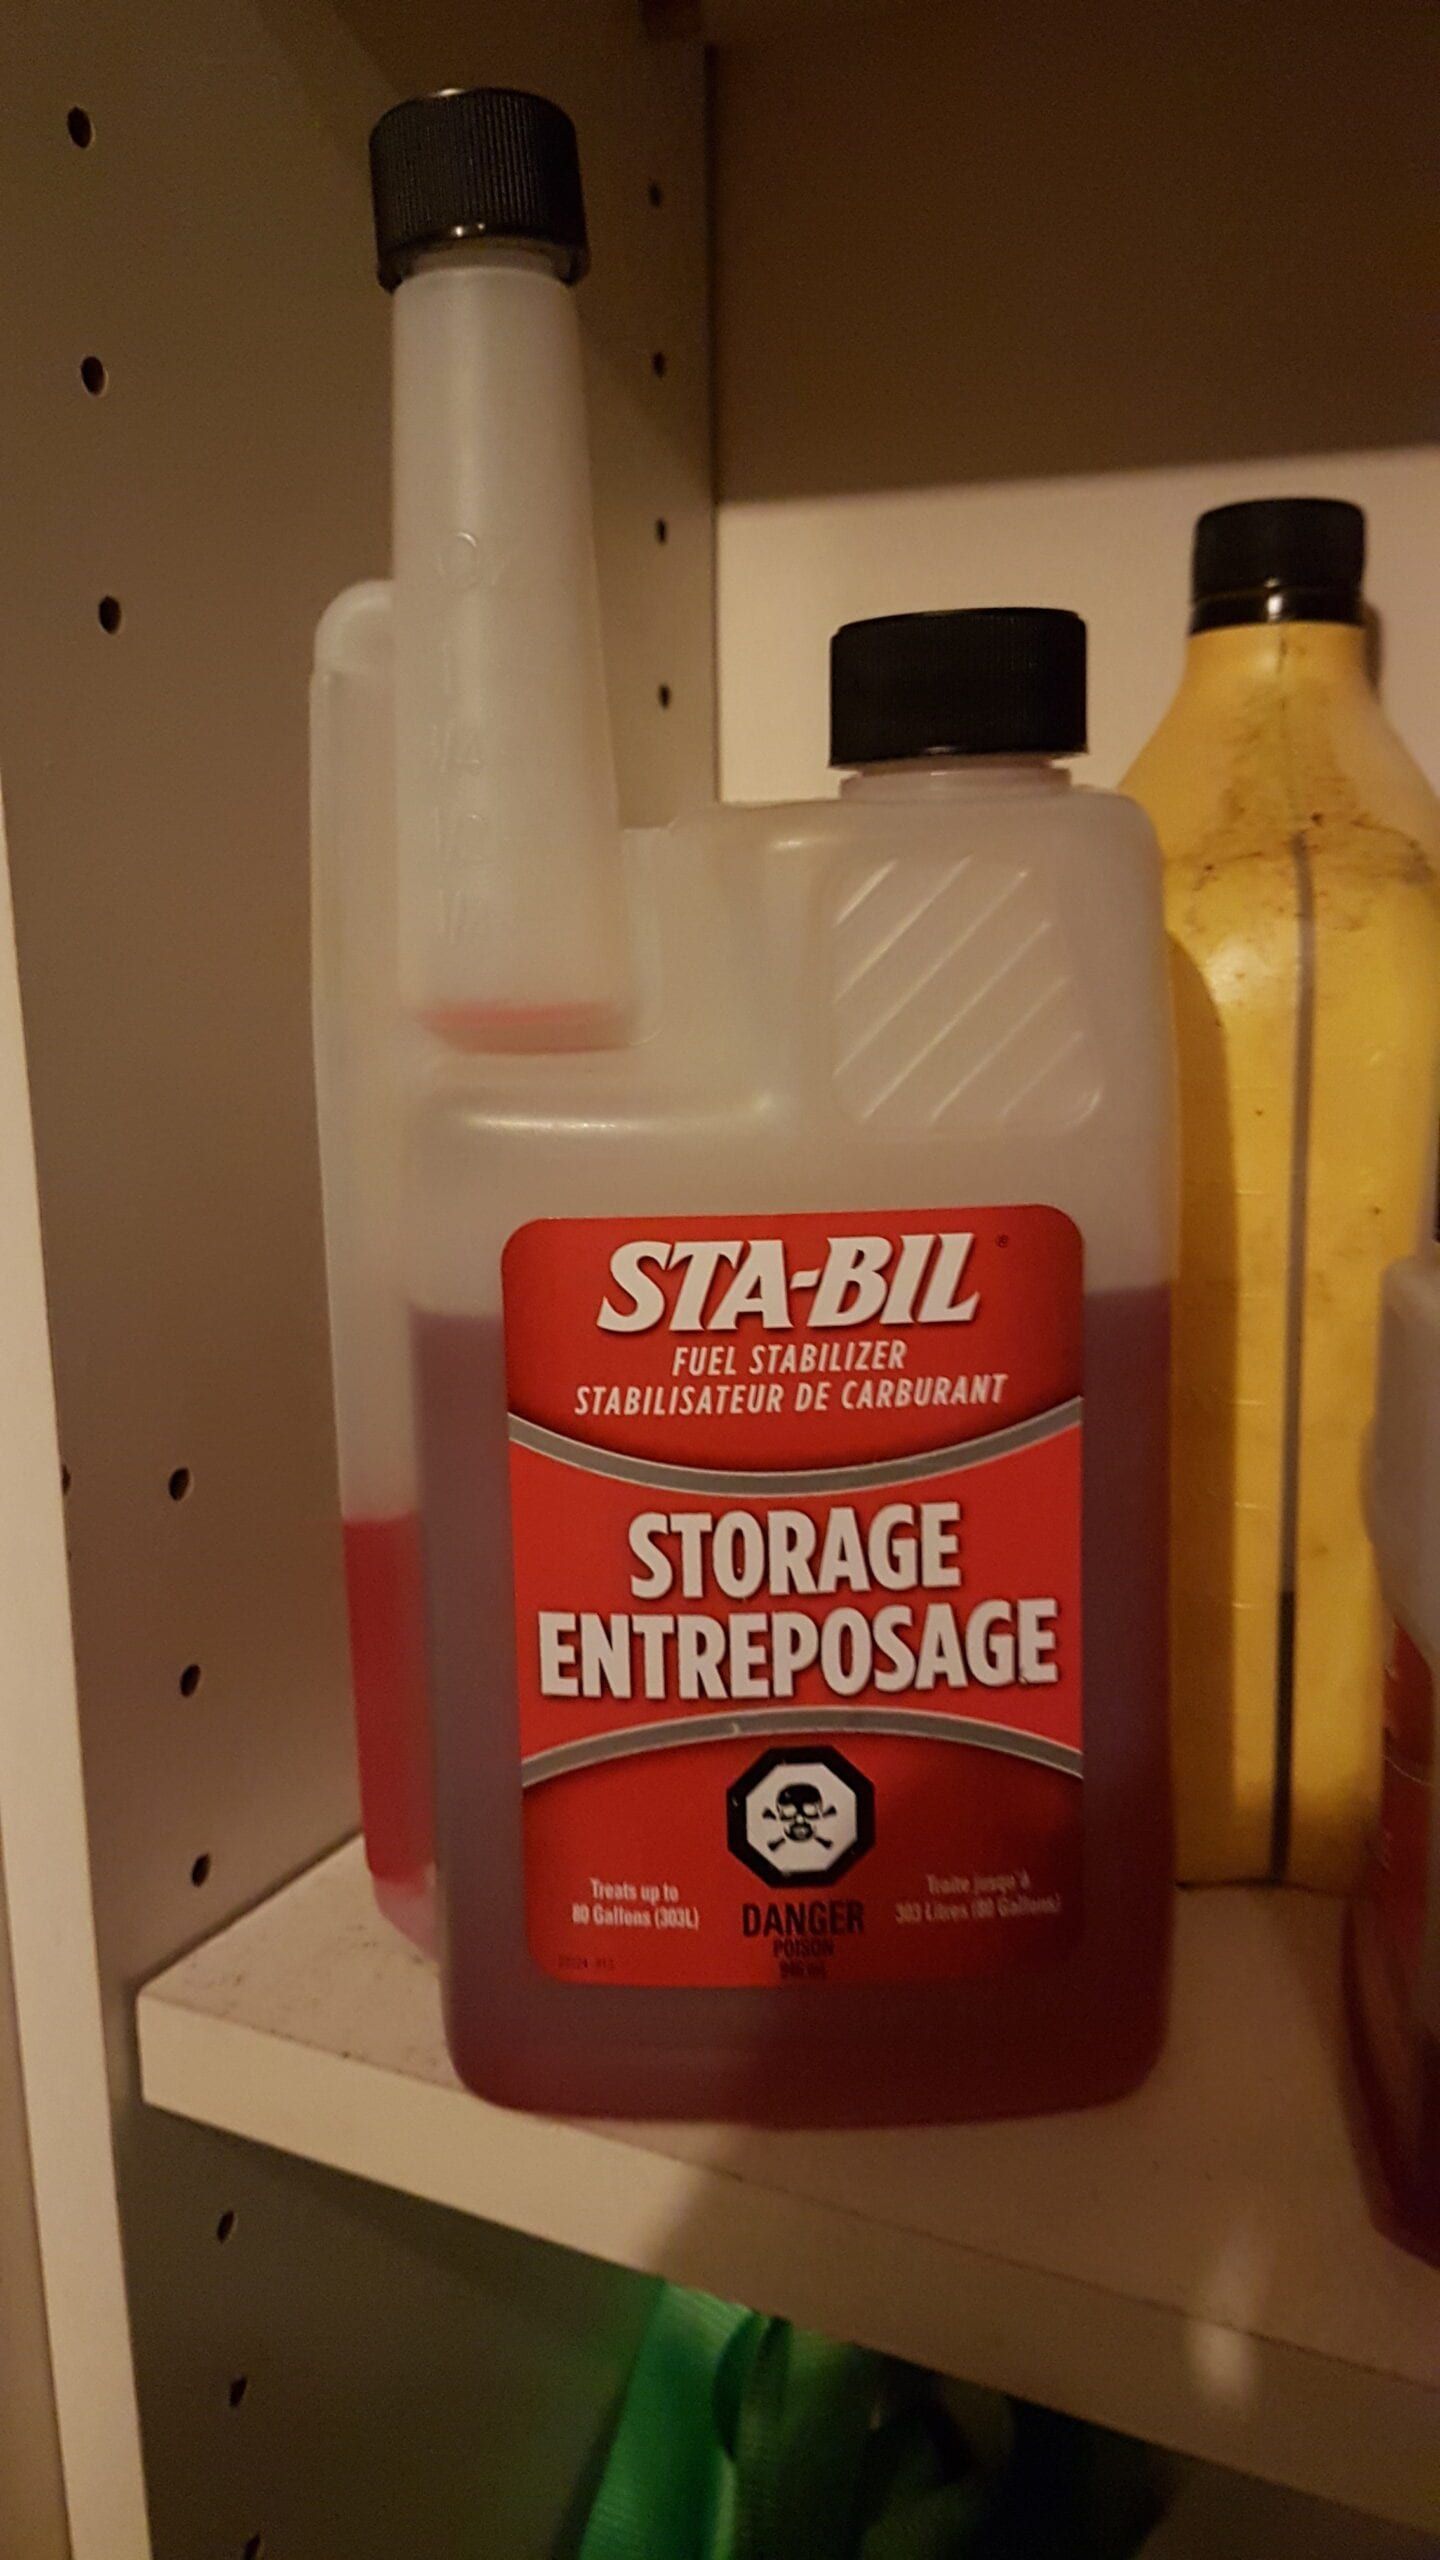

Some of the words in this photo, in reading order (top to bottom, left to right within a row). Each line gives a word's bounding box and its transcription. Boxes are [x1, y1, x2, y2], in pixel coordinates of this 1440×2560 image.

[596, 1232, 981, 1333] STA-BIL
[672, 1346, 736, 1377] FUEL
[749, 1340, 908, 1375] STABILIZER
[574, 1384, 783, 1416] STABILISATEUR
[795, 1382, 829, 1411] DE
[841, 1374, 1008, 1410] CARBURANT
[628, 1501, 962, 1600] STORAGE
[537, 1598, 1058, 1700] ENTREPOSAGE
[590, 1877, 637, 1901] Treats
[640, 1884, 661, 1906] up
[662, 1881, 680, 1903] to
[592, 1902, 652, 1928] Gallons
[654, 1905, 700, 1931] (303L)
[741, 1900, 865, 1938] DANGER
[773, 1939, 835, 1959] POISON
